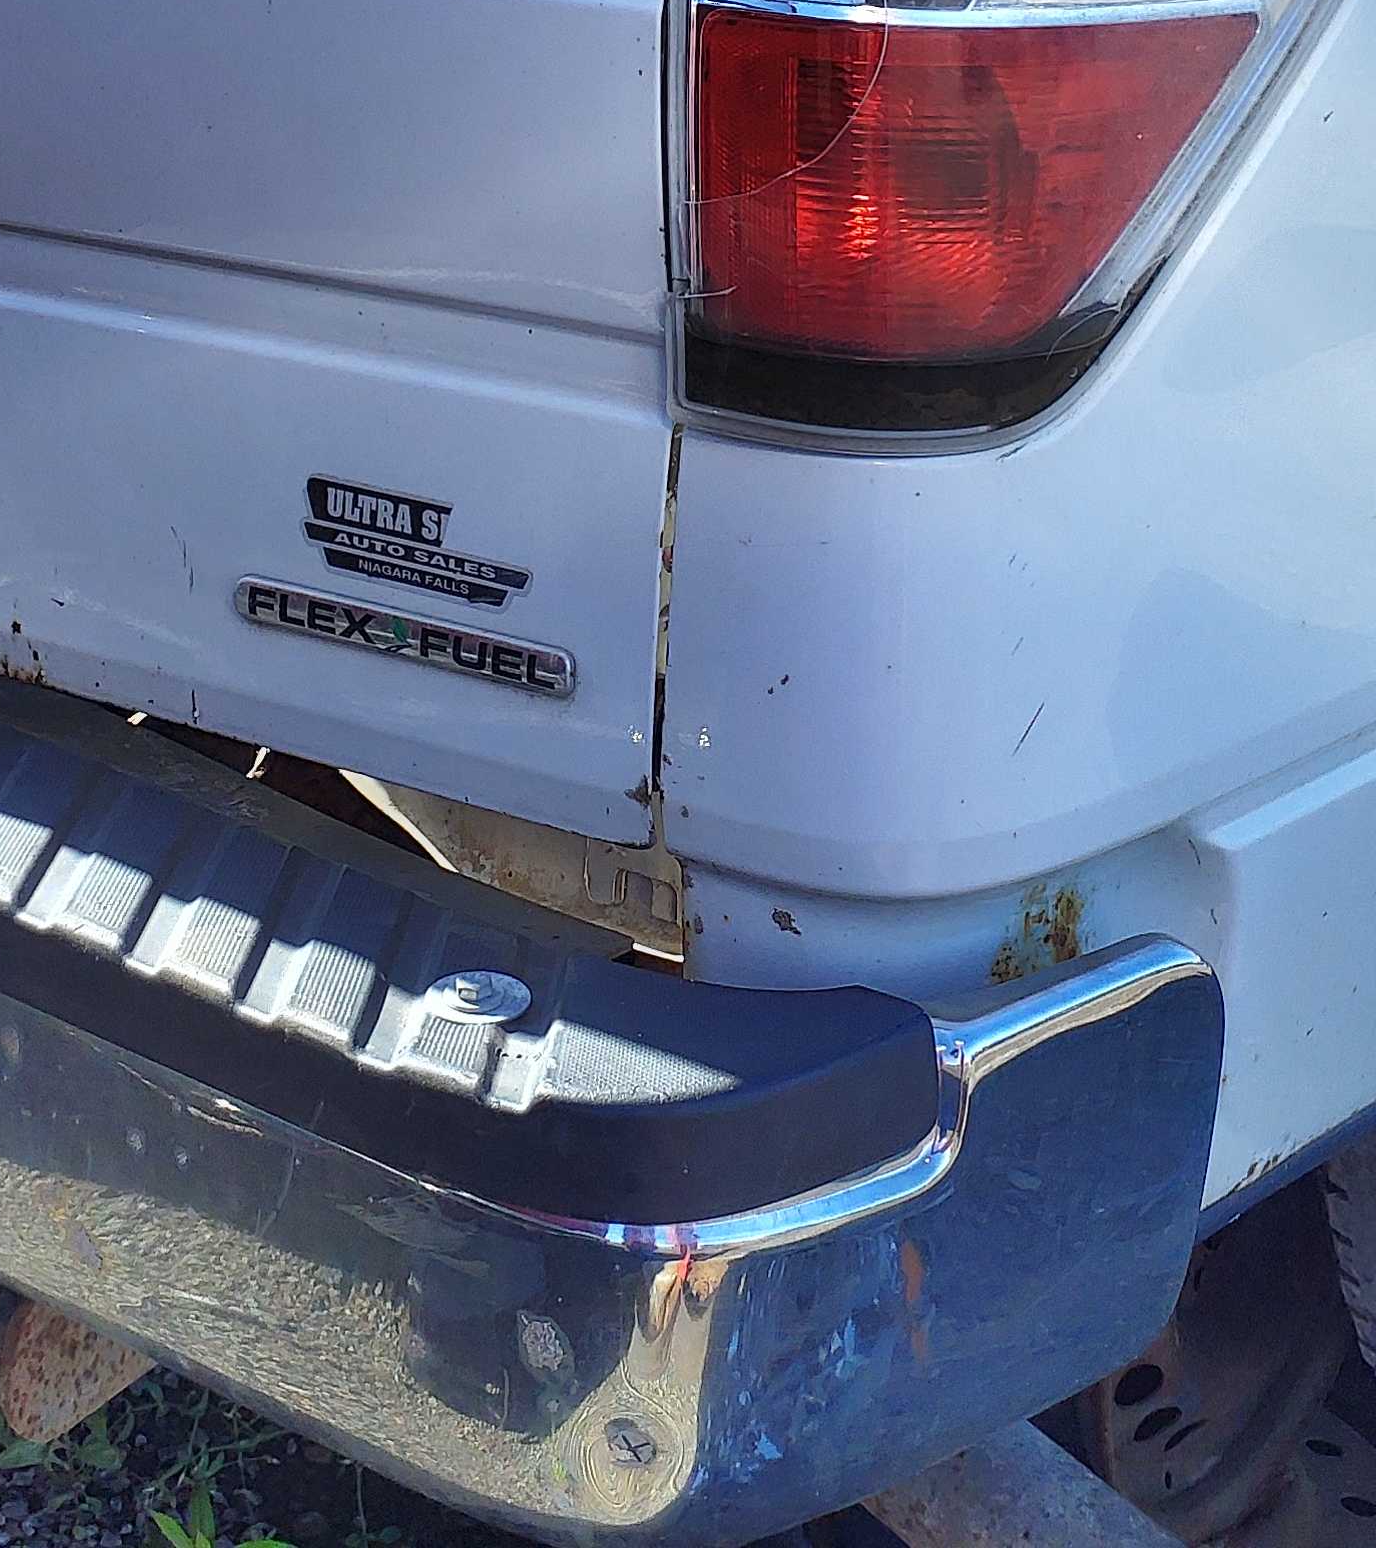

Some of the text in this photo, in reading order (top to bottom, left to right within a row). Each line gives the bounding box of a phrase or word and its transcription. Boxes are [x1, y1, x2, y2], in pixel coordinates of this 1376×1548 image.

[325, 486, 413, 535] ULTRA
[332, 531, 498, 581] AUTO SALES
[358, 558, 472, 596] NIAGARA FALLS
[247, 585, 567, 691] FLEX FUEL
